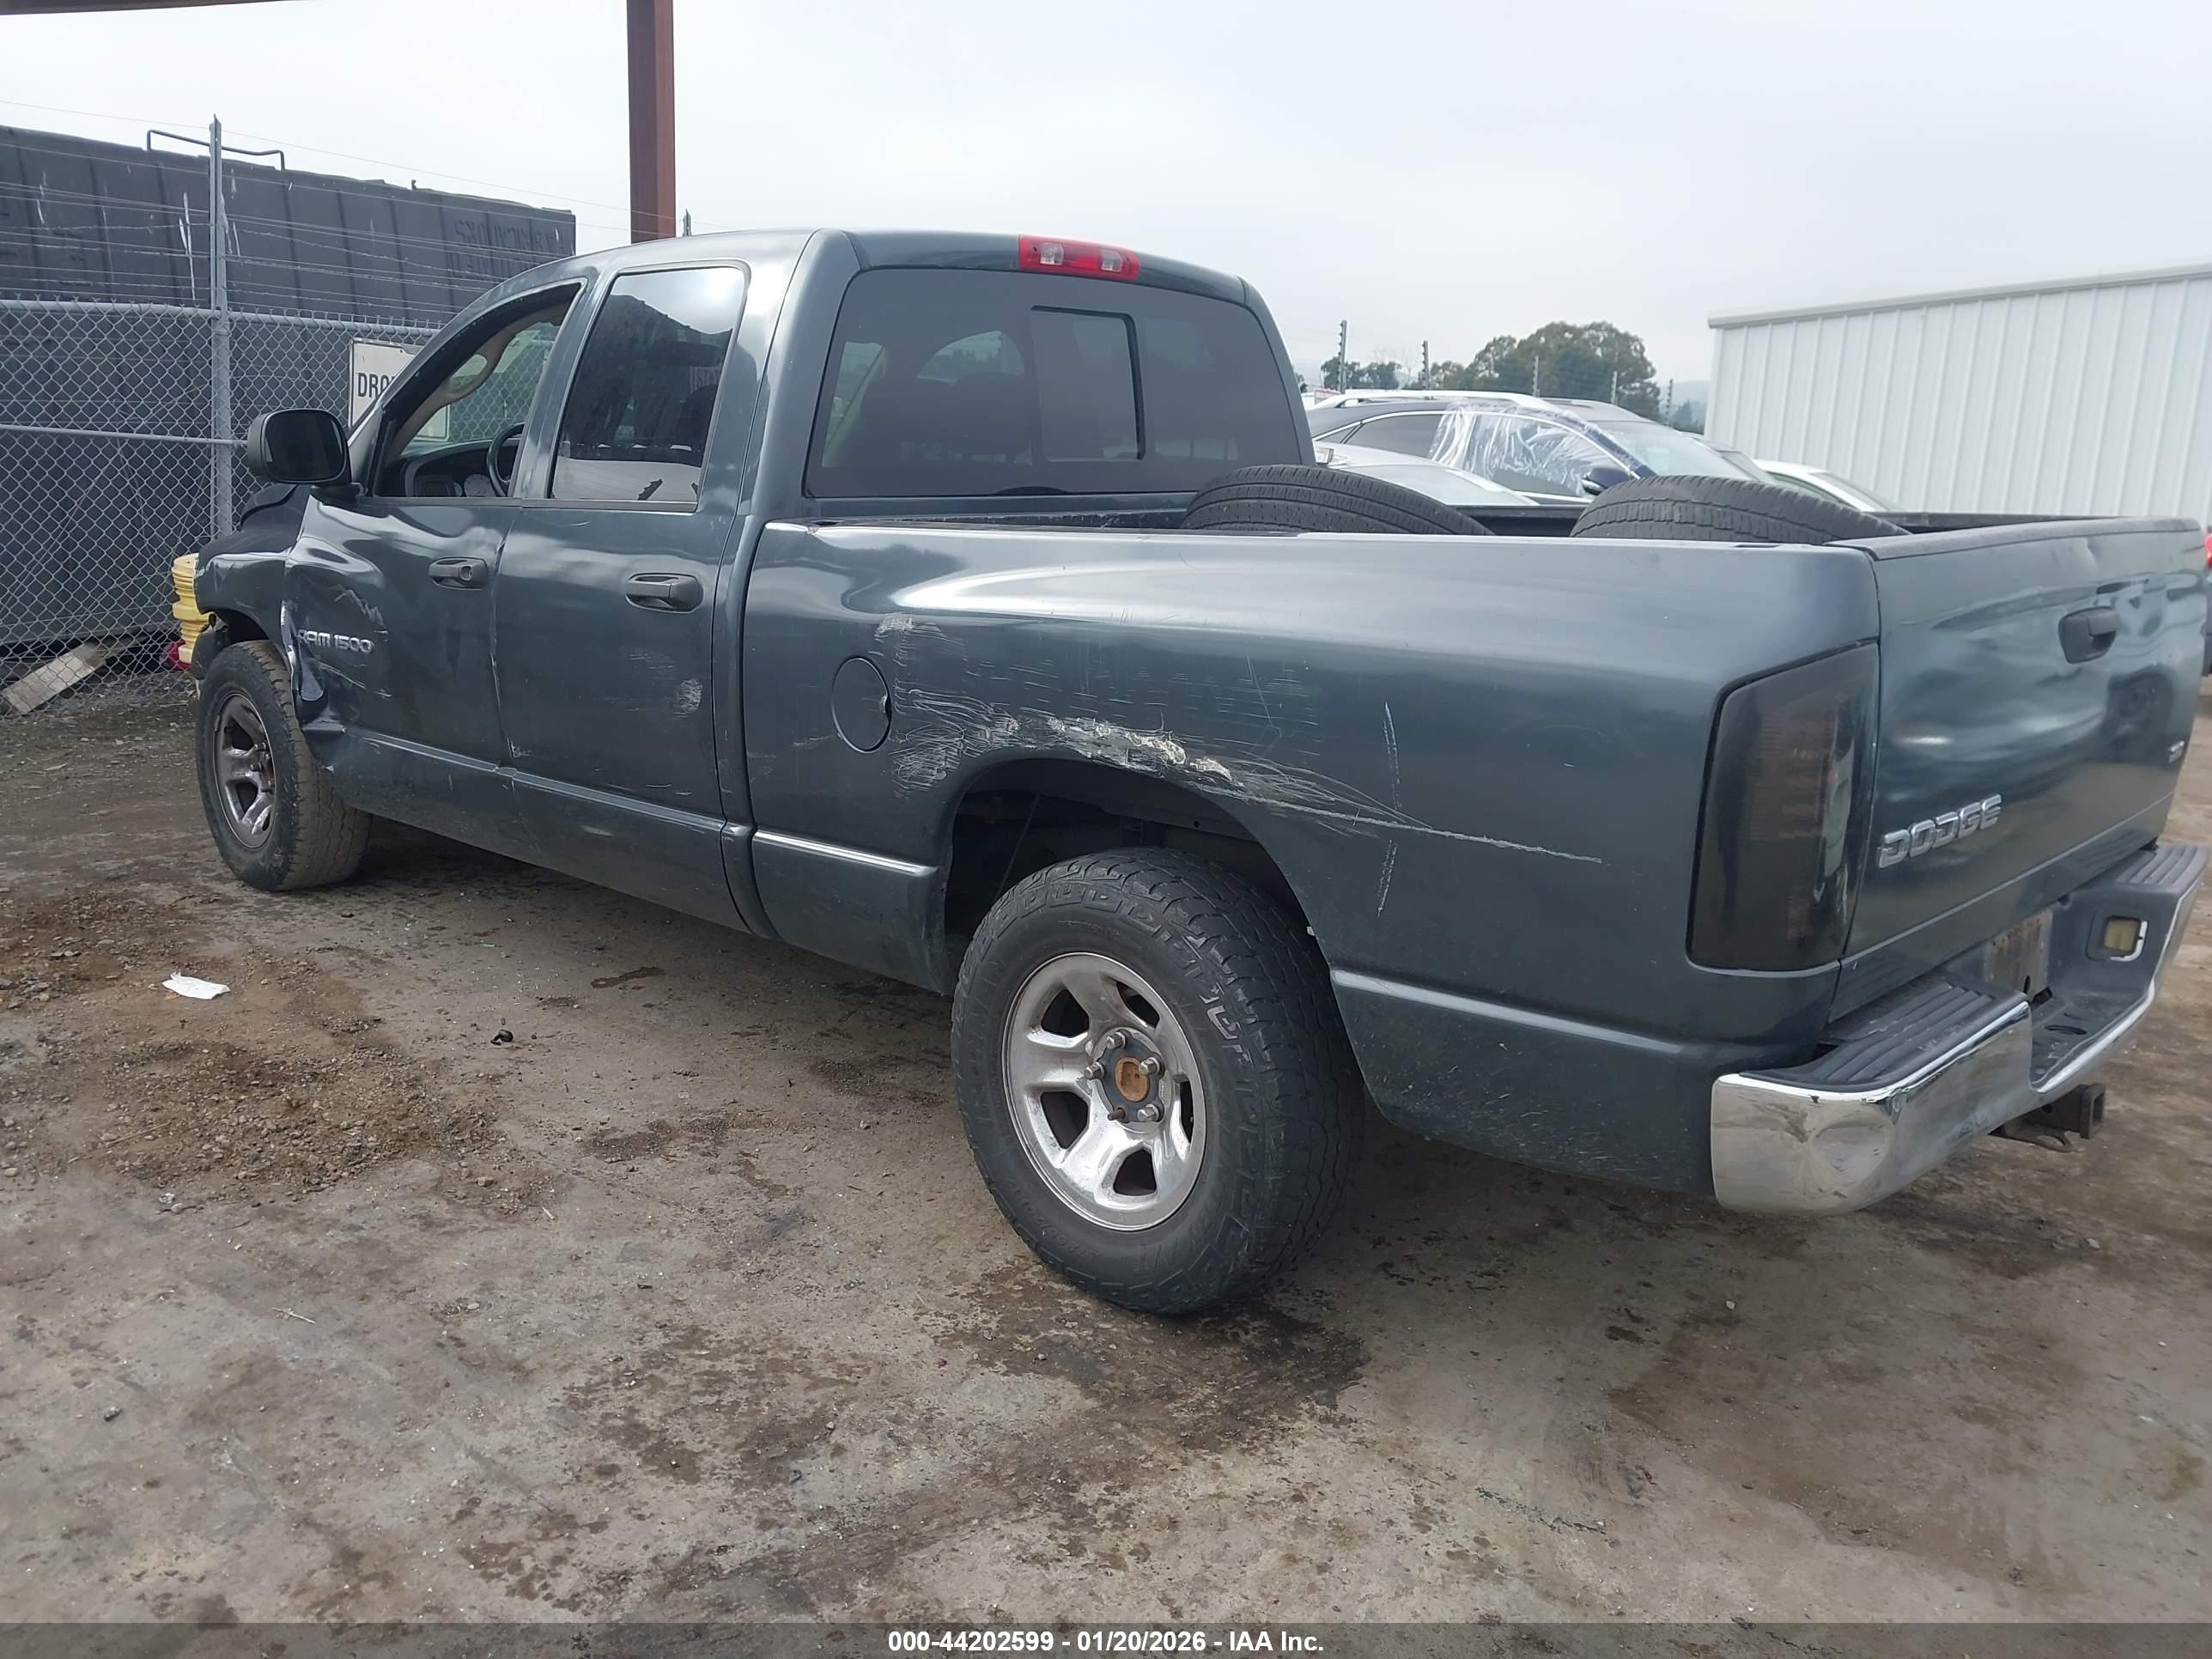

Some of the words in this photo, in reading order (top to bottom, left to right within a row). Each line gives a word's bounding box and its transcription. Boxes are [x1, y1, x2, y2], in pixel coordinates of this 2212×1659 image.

[357, 372, 395, 398] DRO
[297, 629, 331, 648] RAM
[333, 635, 373, 653] 1500
[1878, 794, 2002, 868] DODGE
